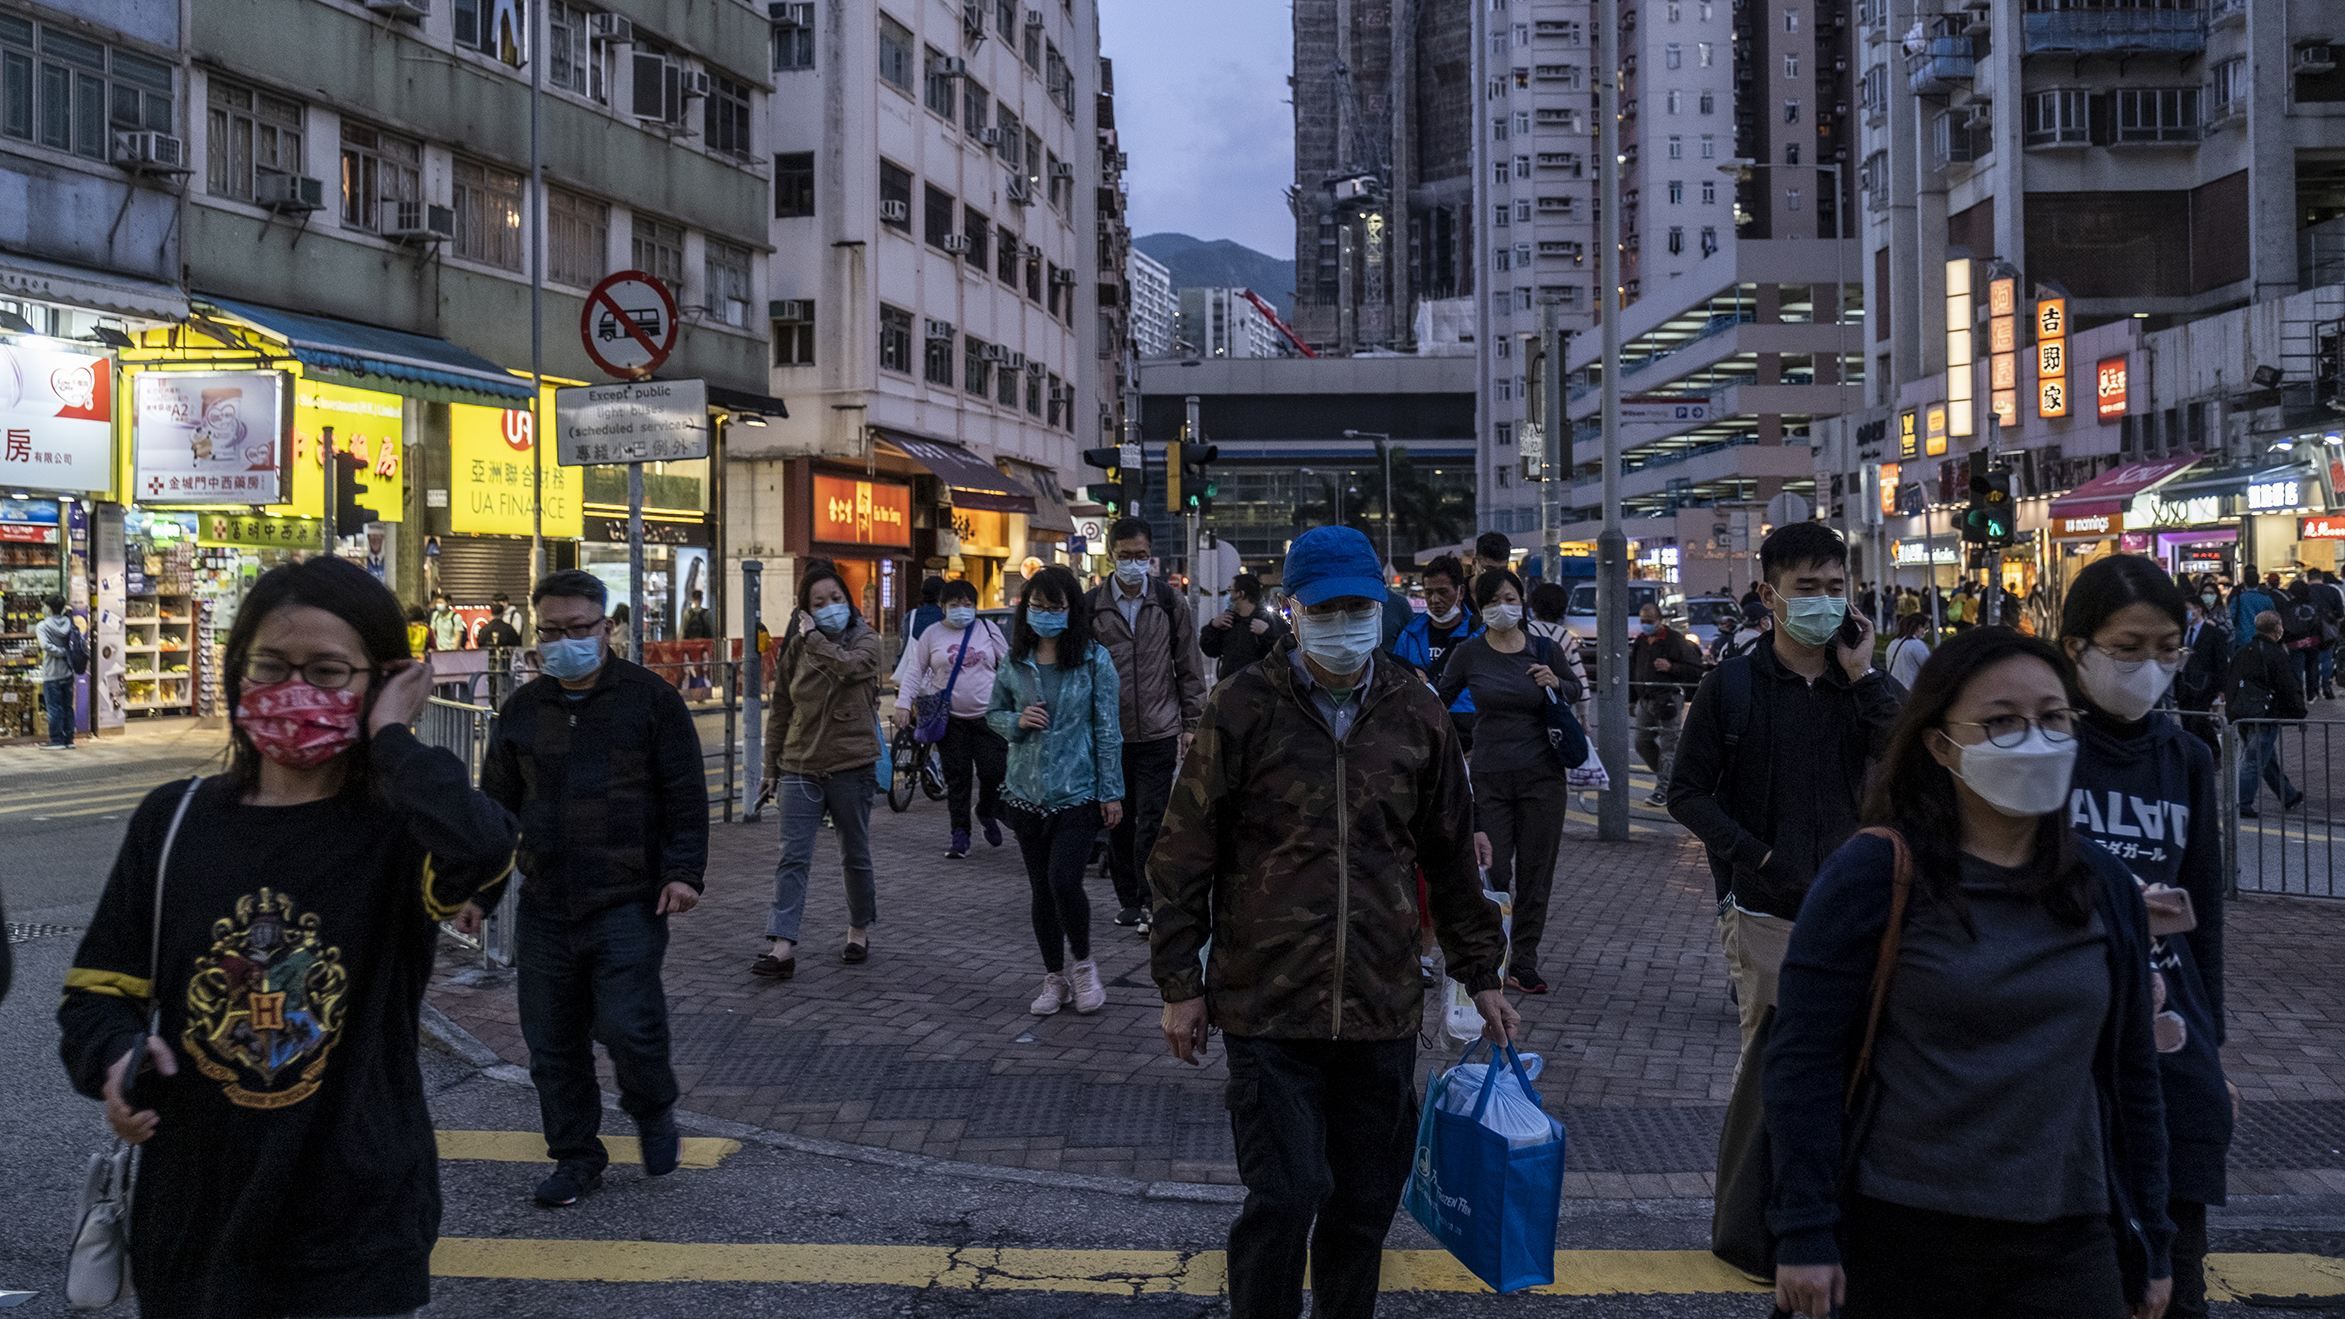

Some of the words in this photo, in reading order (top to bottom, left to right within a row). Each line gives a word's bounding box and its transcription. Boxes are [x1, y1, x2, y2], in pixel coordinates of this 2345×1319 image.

[2041, 307, 2062, 410] 吉野家
[588, 389, 628, 403] Except
[635, 387, 671, 400] public
[597, 407, 624, 419] light
[631, 404, 665, 416] buses
[568, 422, 634, 439] (scheduled
[640, 417, 695, 434] services)
[34, 451, 73, 465] 有限公司
[471, 490, 494, 514] UA
[255, 997, 278, 1026] H
